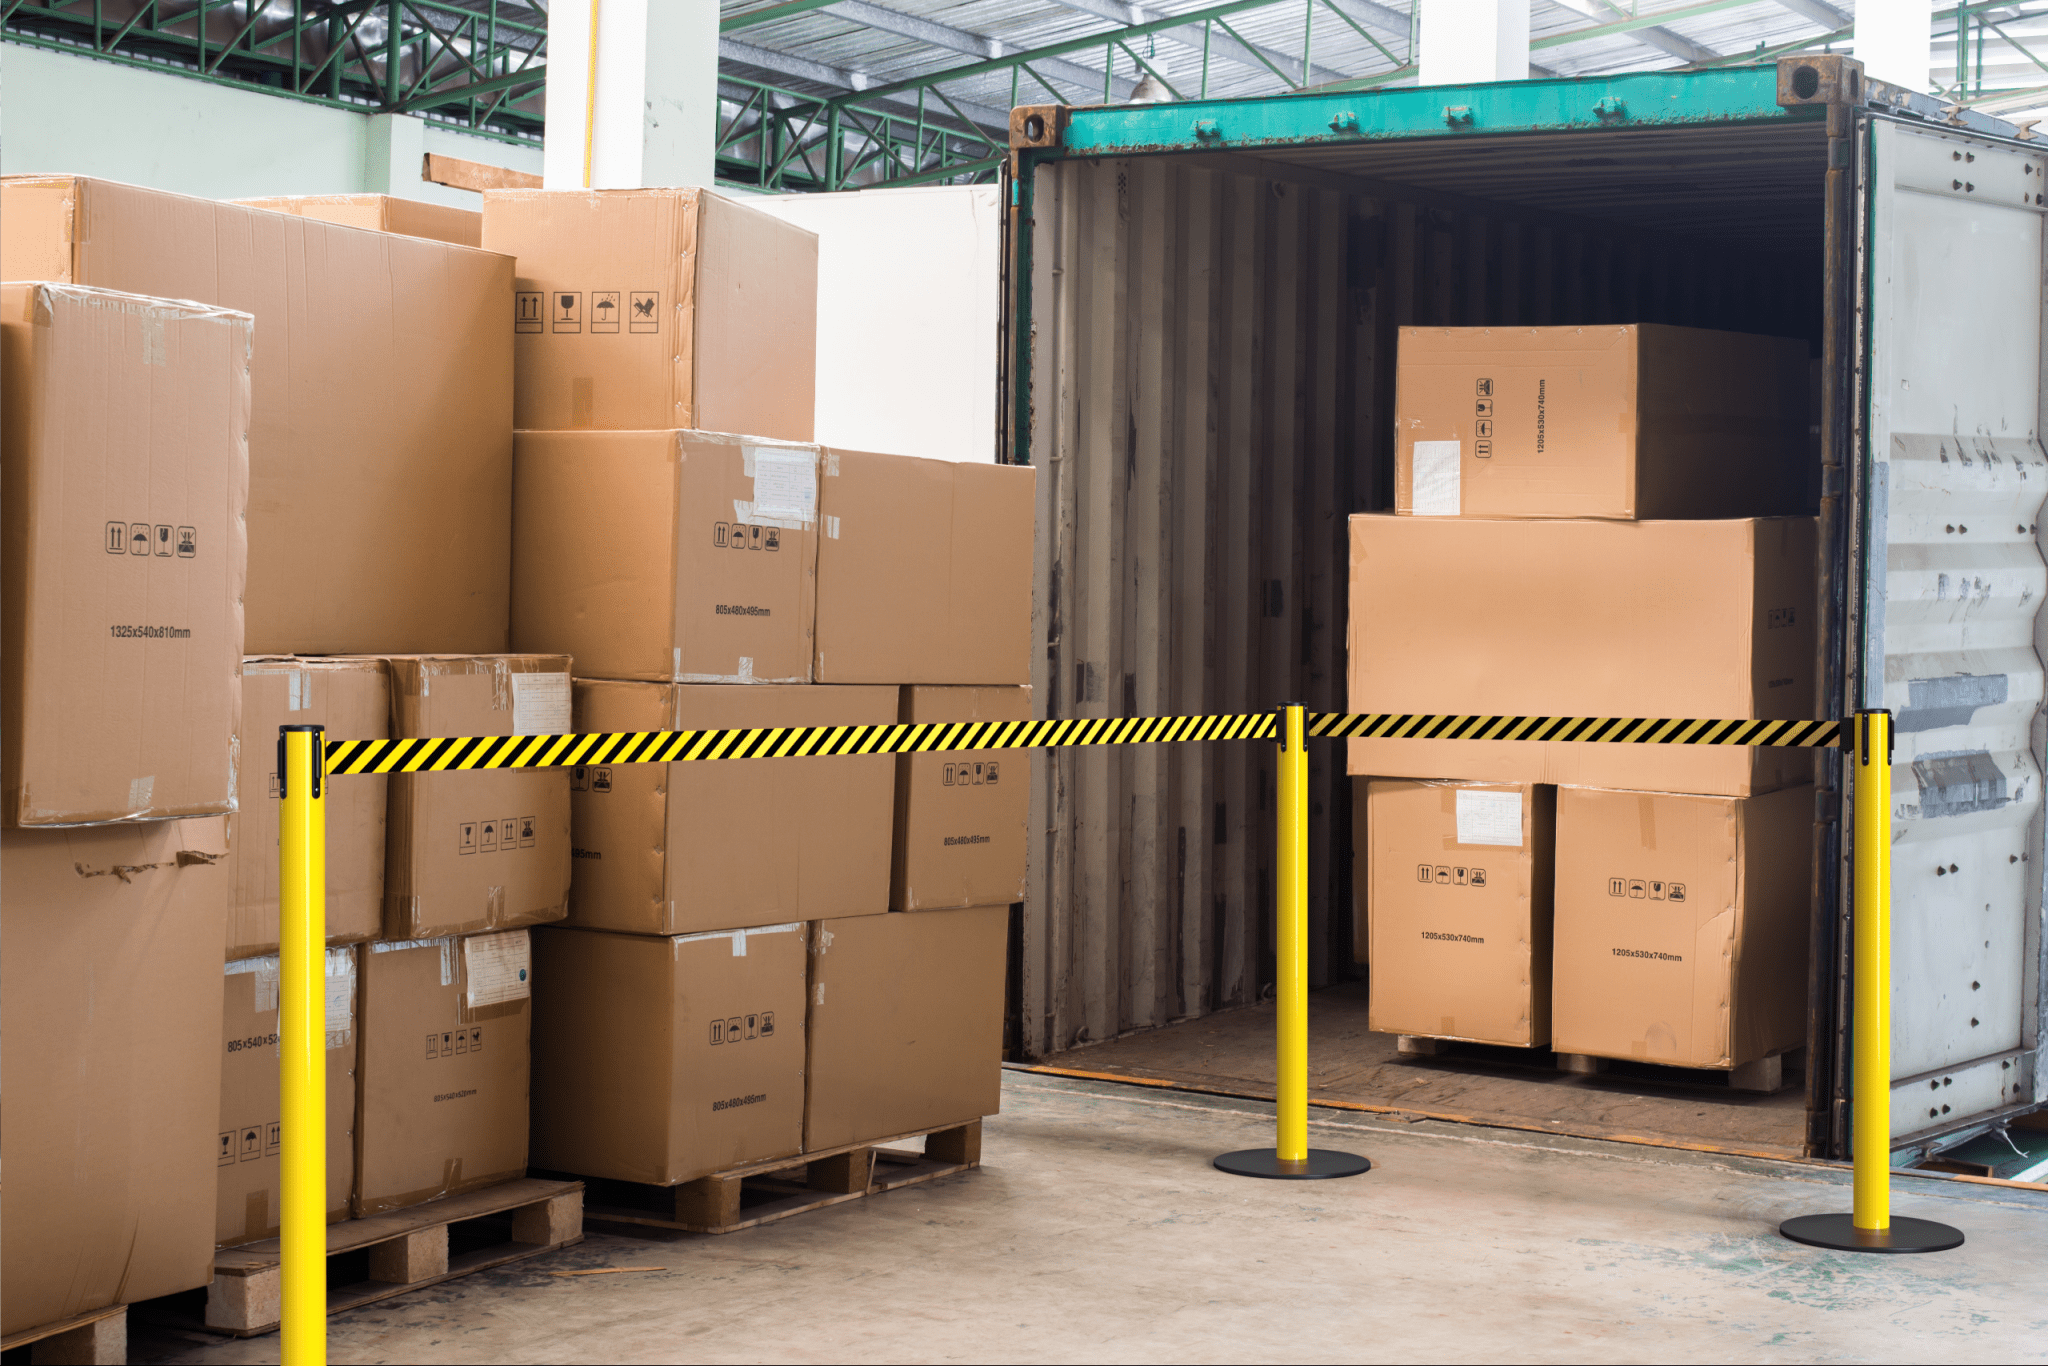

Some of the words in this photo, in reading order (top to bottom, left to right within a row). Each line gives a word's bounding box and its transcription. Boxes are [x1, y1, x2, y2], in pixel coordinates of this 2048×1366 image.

[1537, 379, 1546, 453] 1205x530x740mm
[715, 604, 771, 617] 805x480x495mm
[110, 625, 191, 638] 1325x540x810mm
[1421, 931, 1485, 944] 1205x530x740mm
[1612, 948, 1683, 962] 1205x530x740mm
[227, 1033, 279, 1053] 805x540x52
[712, 1094, 767, 1112] 805x480x495mm
